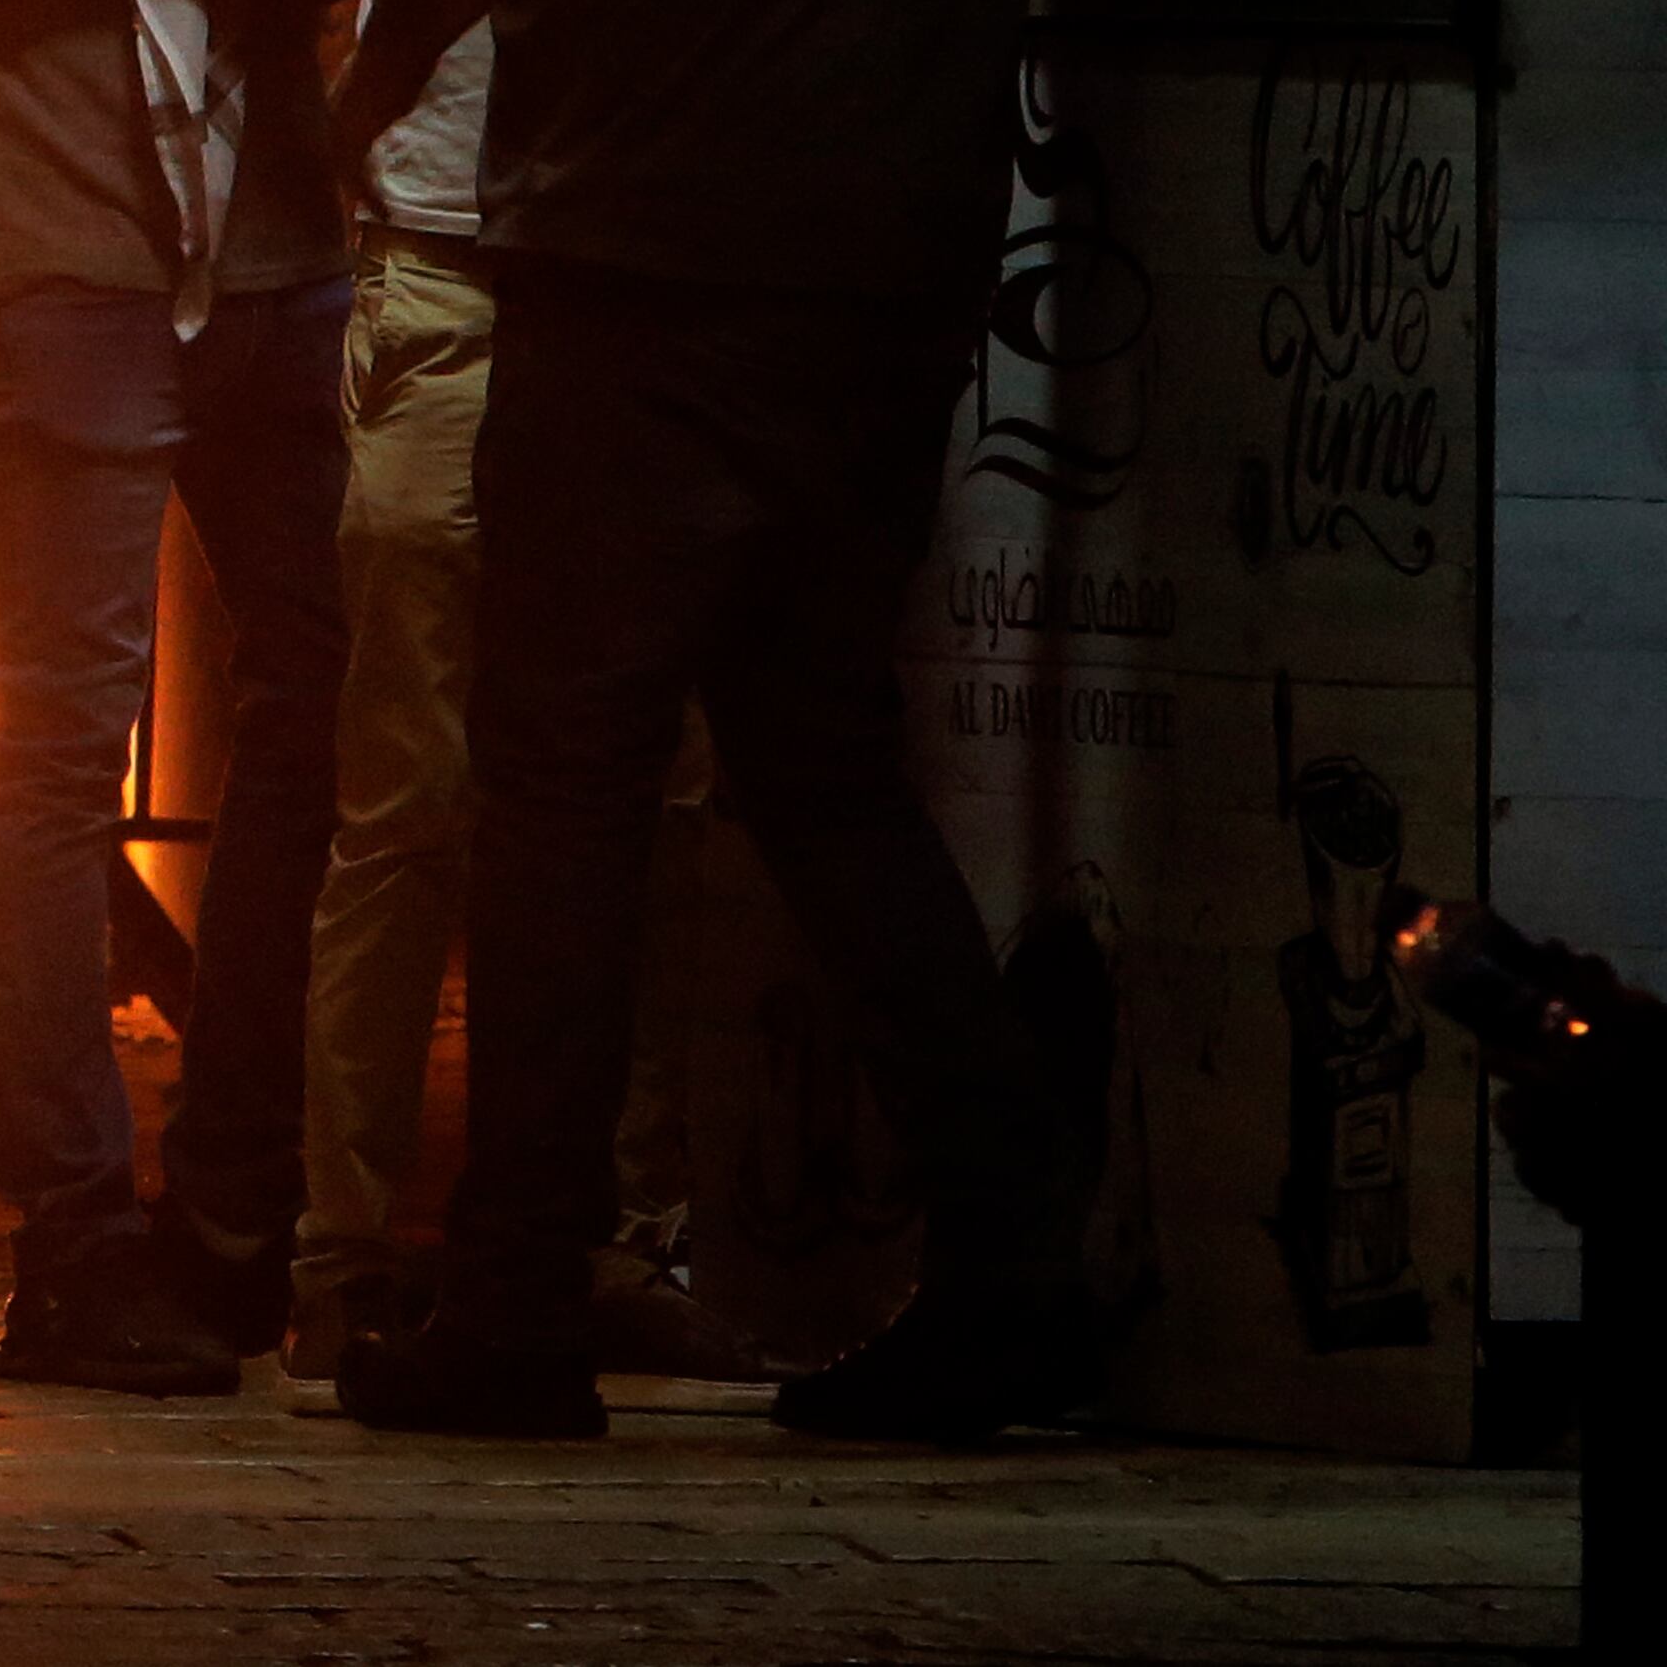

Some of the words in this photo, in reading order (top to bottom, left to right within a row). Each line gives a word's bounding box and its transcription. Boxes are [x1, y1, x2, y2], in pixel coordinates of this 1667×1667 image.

[1249, 54, 1458, 340] Coffee
[1261, 286, 1447, 548] Time
[950, 681, 982, 736] AL
[1071, 688, 1177, 748] COFFEE
